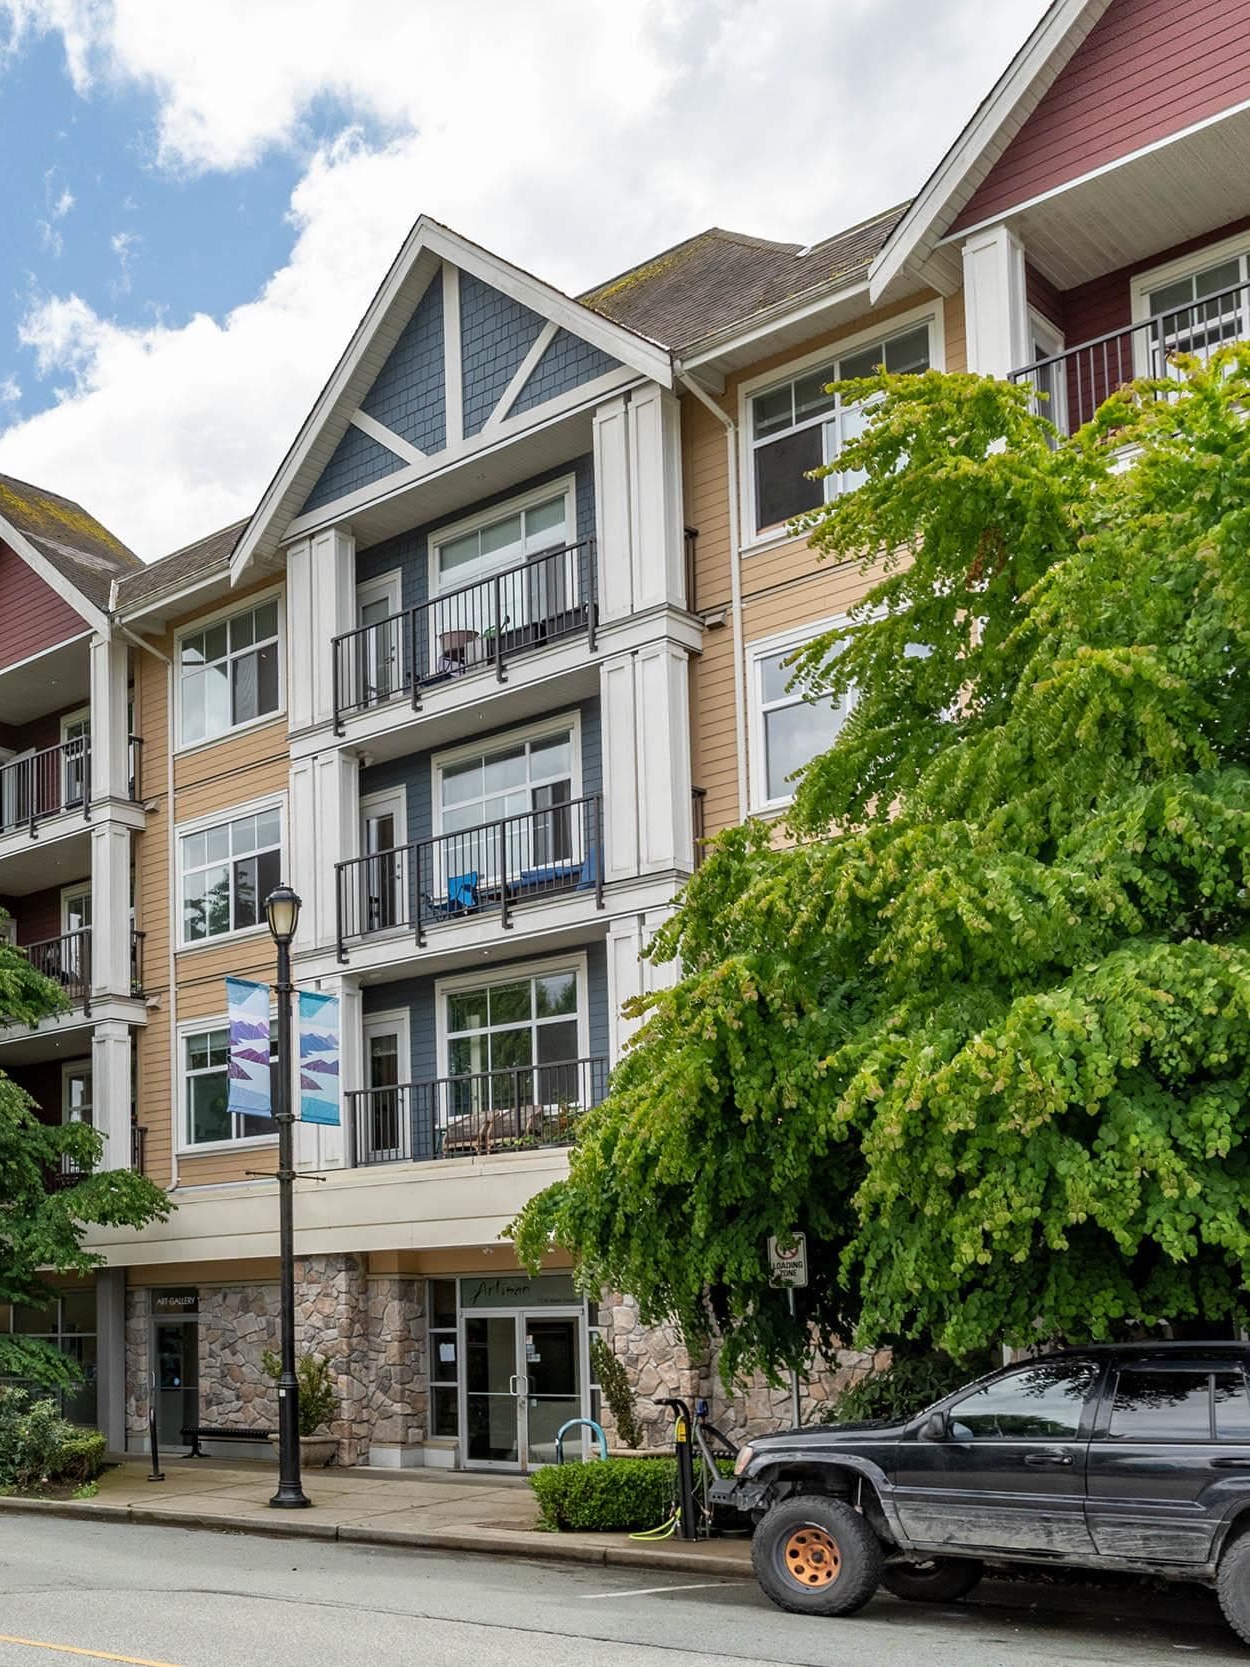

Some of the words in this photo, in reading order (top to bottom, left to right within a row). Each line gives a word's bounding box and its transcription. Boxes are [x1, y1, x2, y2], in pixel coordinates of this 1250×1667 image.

[772, 1261, 803, 1269] LOADING
[780, 1269, 797, 1277] ZONE
[157, 1297, 168, 1305] ART
[169, 1296, 196, 1305] GALLERY
